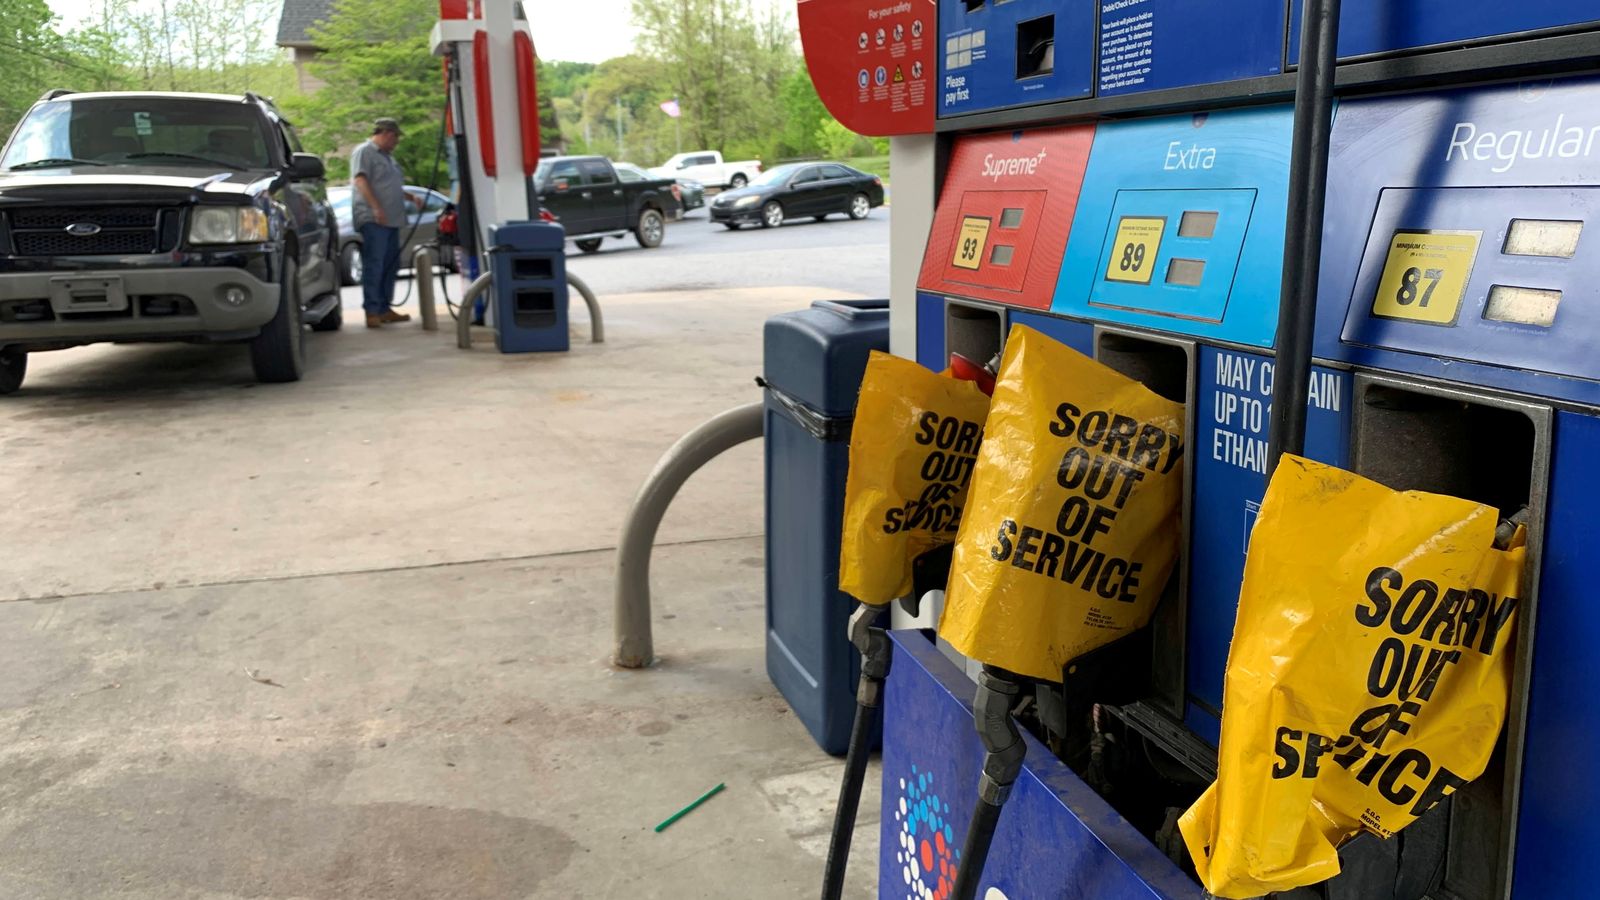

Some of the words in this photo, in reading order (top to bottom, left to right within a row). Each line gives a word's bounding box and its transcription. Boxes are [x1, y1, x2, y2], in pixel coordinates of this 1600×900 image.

[868, 9, 878, 20] For
[879, 7, 892, 20] your
[893, 1, 912, 14] safety
[1111, 20, 1120, 28] bank
[1126, 17, 1136, 25] place
[1139, 12, 1147, 20] hold
[1111, 28, 1124, 36] account
[1133, 22, 1152, 30] authorizes
[1125, 42, 1137, 52] placed
[1143, 40, 1152, 48] your
[1133, 31, 1152, 40] determine
[1123, 61, 1133, 69] other
[1133, 58, 1152, 68] questions
[1125, 51, 1139, 60] amount
[945, 75, 966, 89] Please
[1101, 73, 1118, 82] regarding
[1118, 71, 1127, 79] your
[1125, 77, 1134, 86] card
[945, 92, 957, 106] pay
[957, 87, 970, 101] first
[1163, 141, 1217, 171] Extra
[1445, 113, 1600, 173] Regular
[961, 237, 978, 261] 93
[1119, 242, 1146, 273] 89
[1396, 266, 1444, 308] 87
[1216, 352, 1256, 392] MAY
[1260, 361, 1341, 412] CAIN
[1214, 390, 1237, 426] UP
[1240, 396, 1262, 434] TO
[915, 410, 985, 456] SOR
[1048, 402, 1185, 475] SORRY
[1213, 427, 1269, 475] ETHAN
[920, 450, 978, 489] OUT
[1056, 446, 1146, 510] OUT
[1055, 495, 1118, 546] OF
[990, 519, 1144, 604] SERVICE
[1355, 566, 1519, 656] SORRY
[1366, 637, 1463, 702] OUT
[1349, 701, 1422, 750] OF
